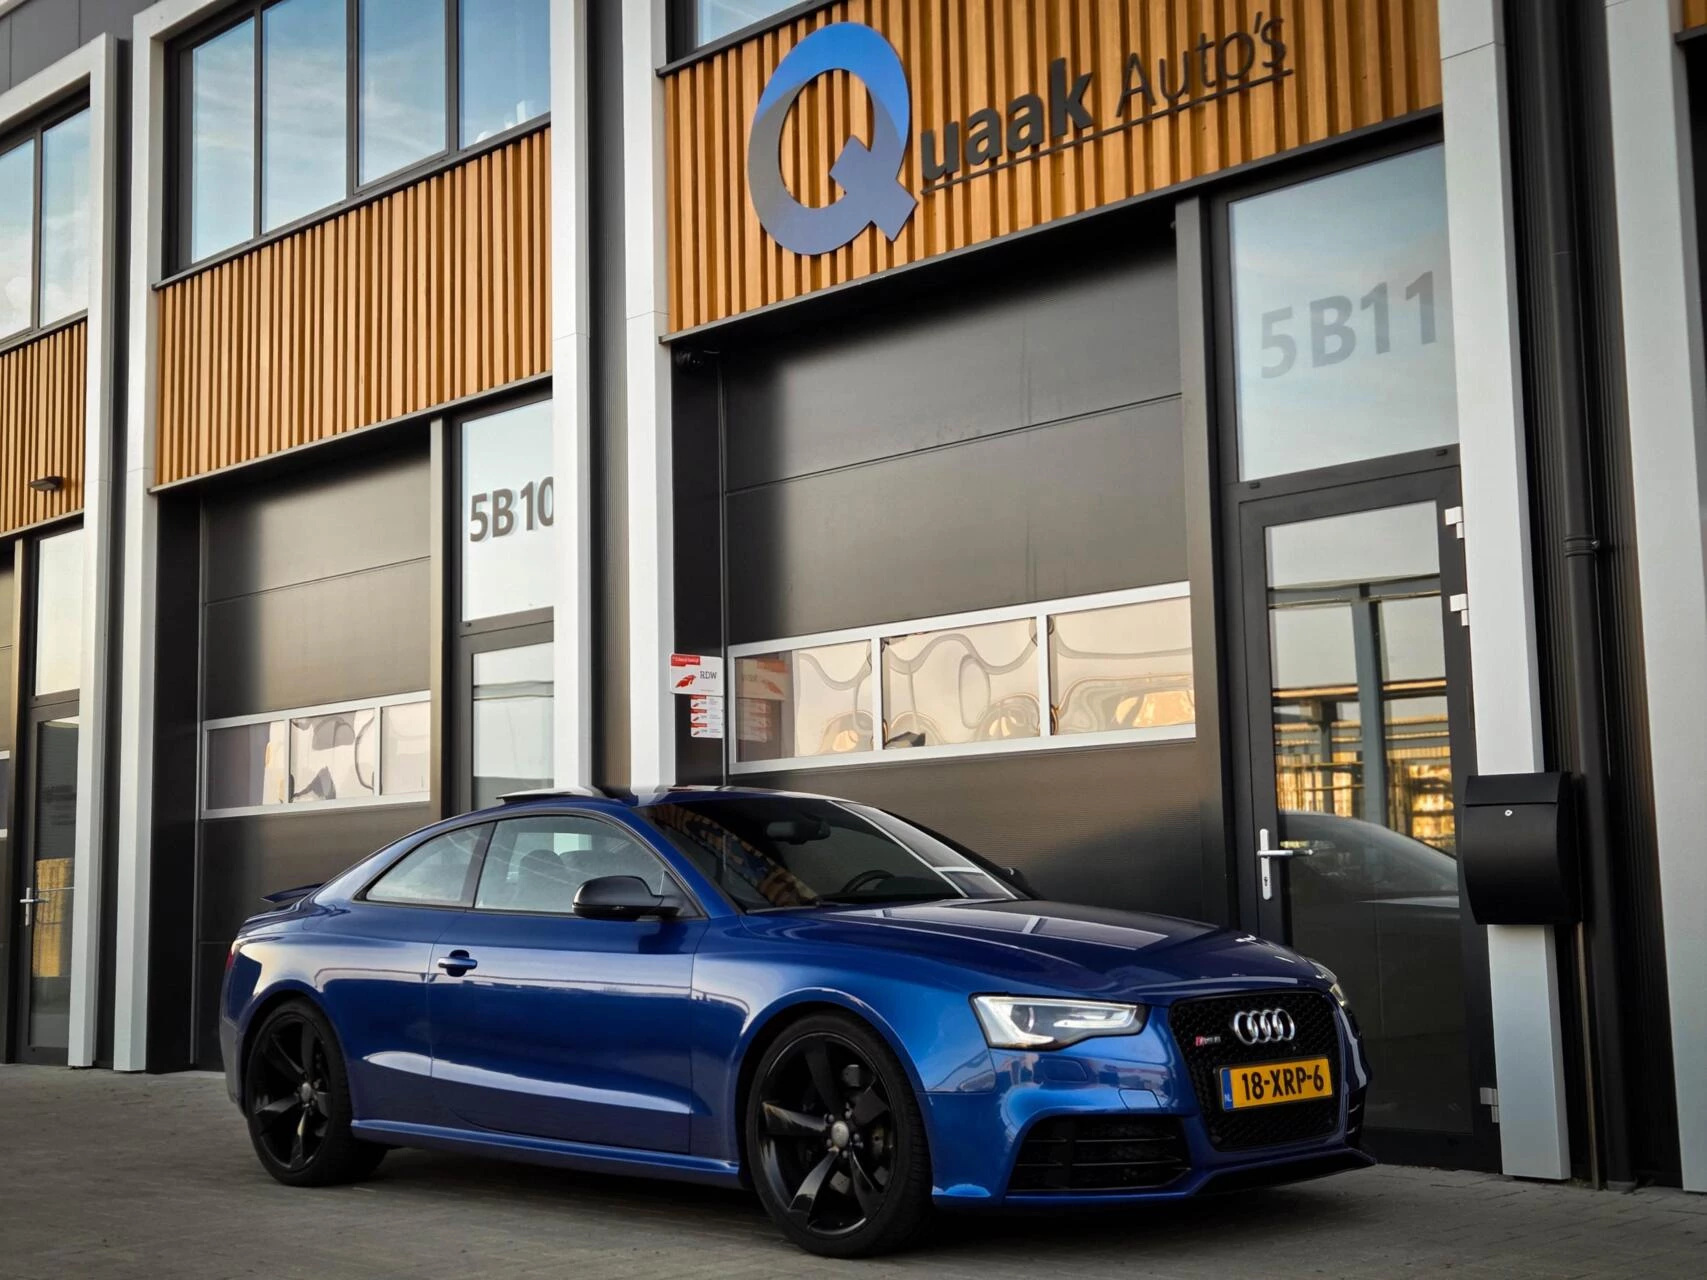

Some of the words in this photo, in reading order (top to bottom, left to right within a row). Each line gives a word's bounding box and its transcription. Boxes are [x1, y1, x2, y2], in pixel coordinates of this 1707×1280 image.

[748, 21, 1094, 256] Quaak
[1116, 11, 1286, 117] Auto's
[1261, 270, 1437, 379] 5B11
[470, 476, 554, 542] 5B10
[699, 671, 717, 680] RDW
[1241, 1064, 1324, 1101] 18-XRP-6
